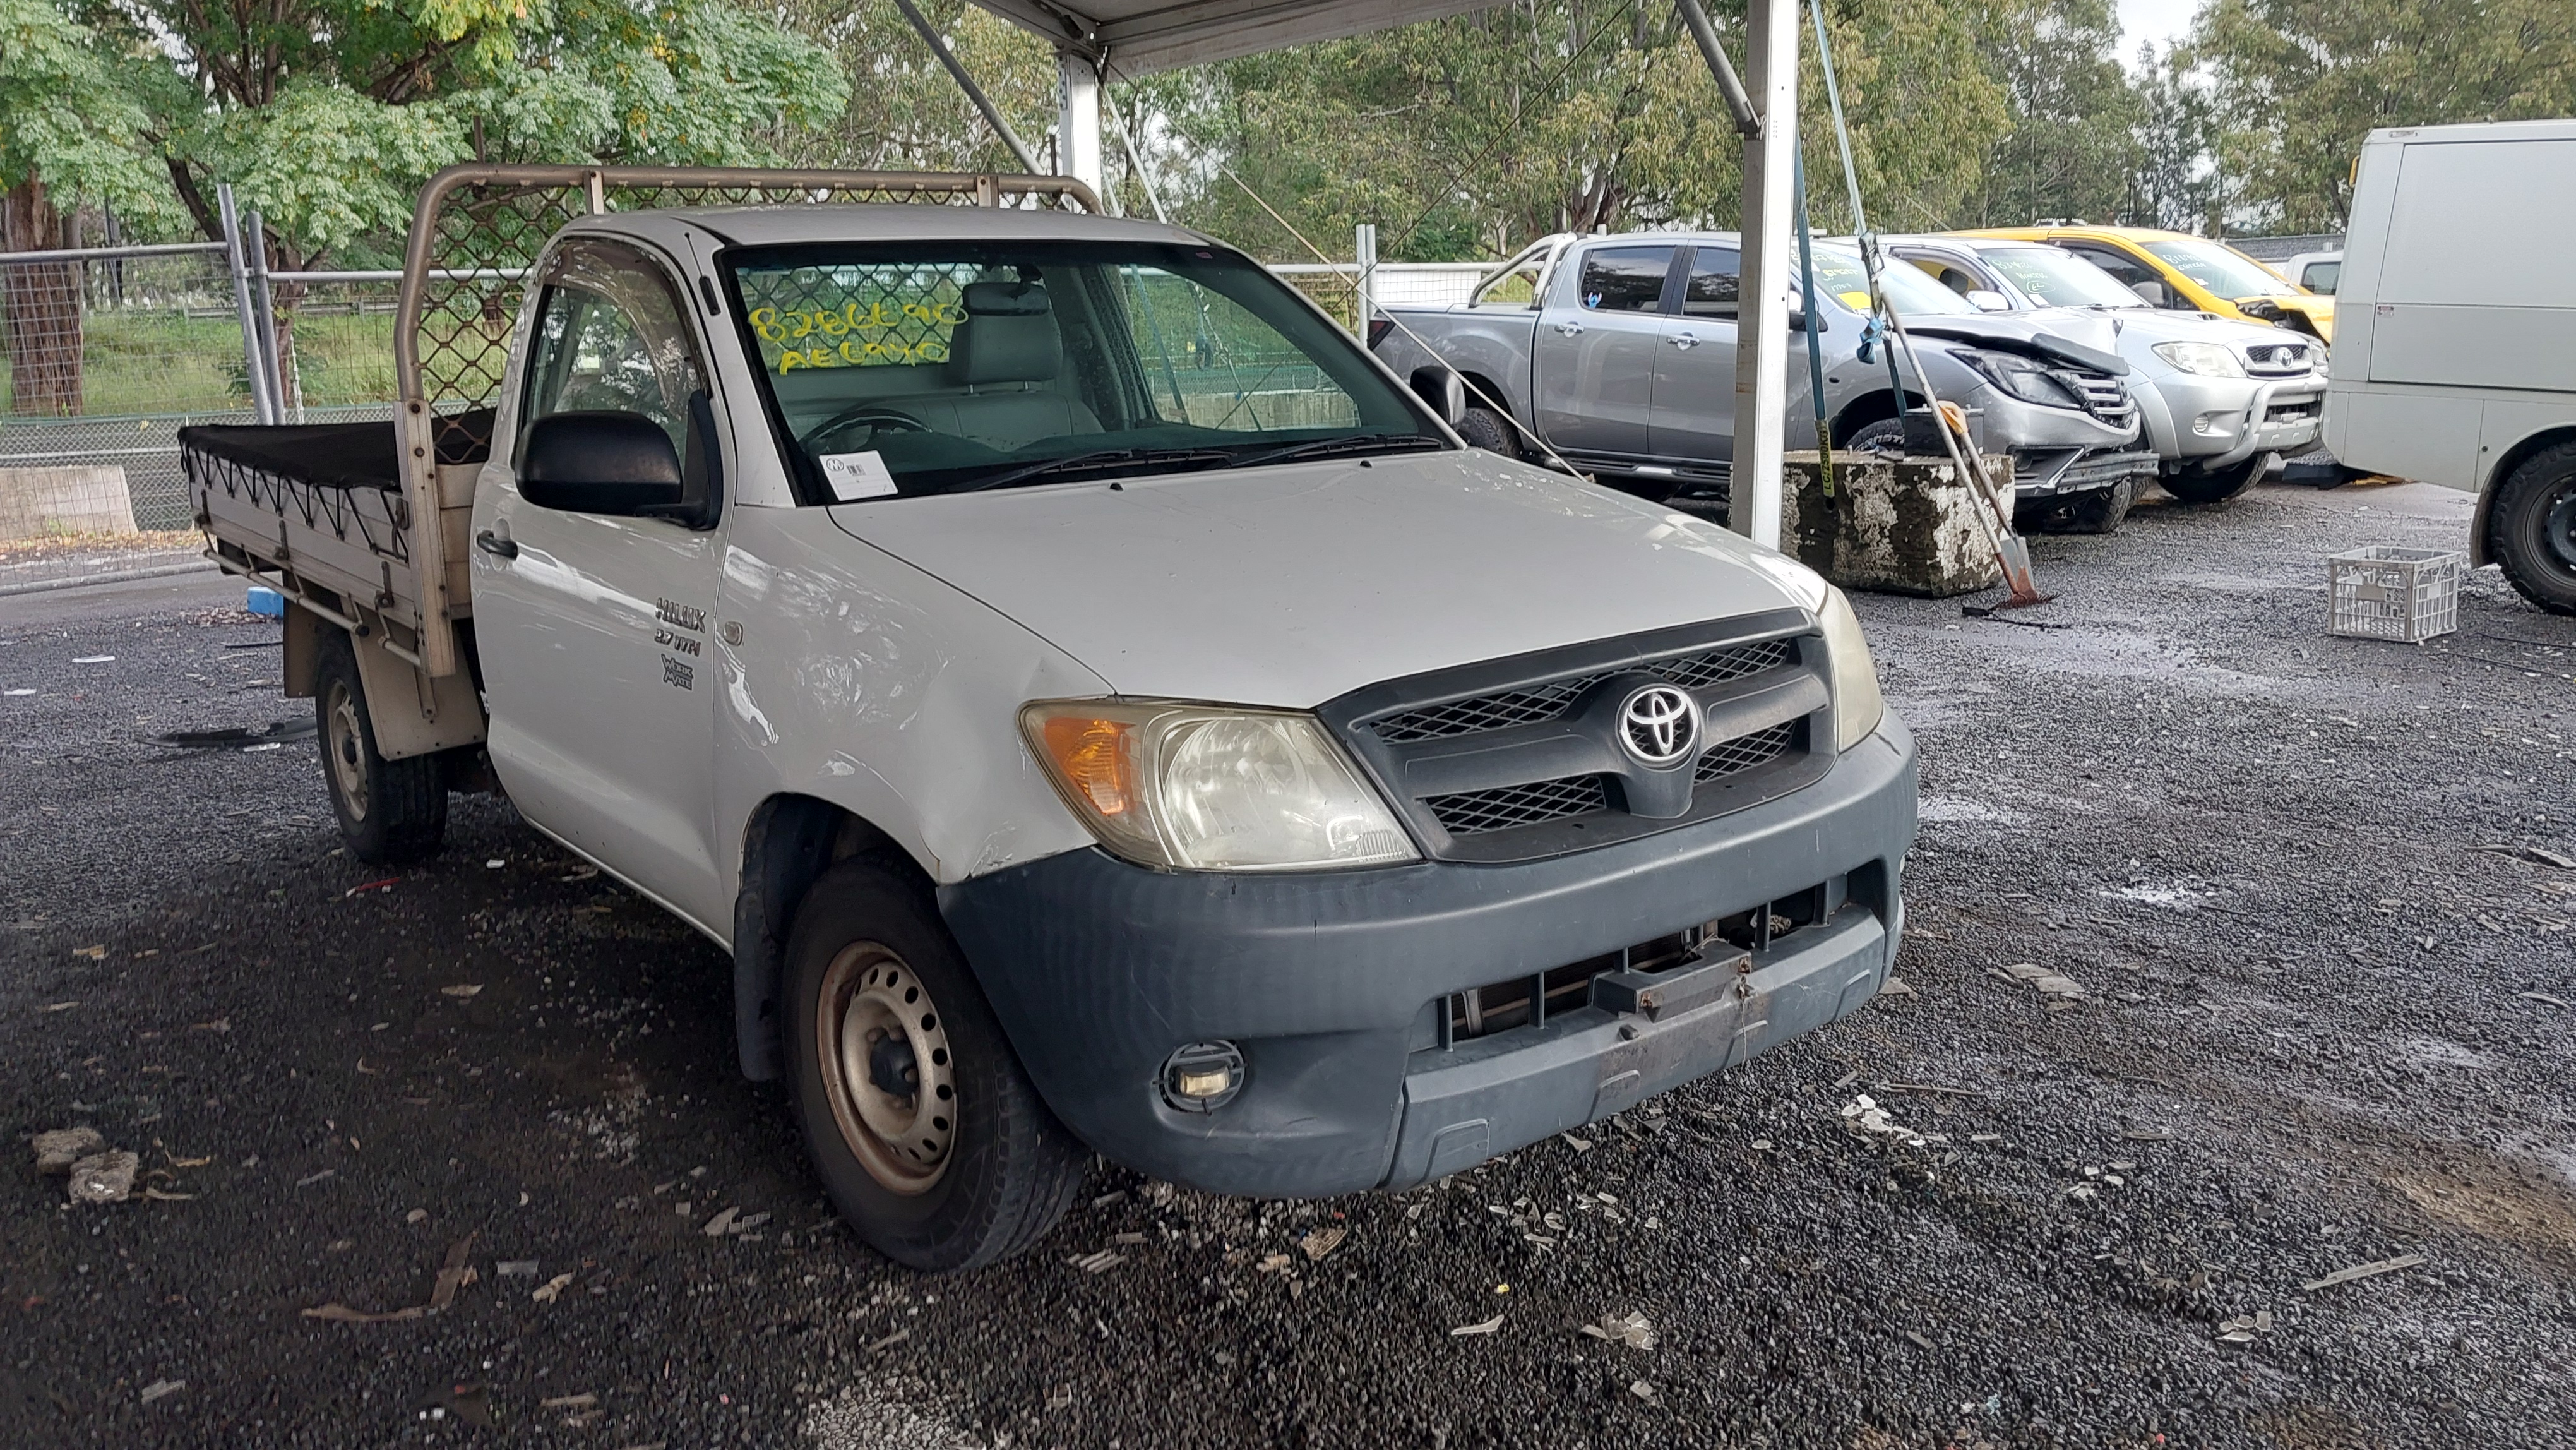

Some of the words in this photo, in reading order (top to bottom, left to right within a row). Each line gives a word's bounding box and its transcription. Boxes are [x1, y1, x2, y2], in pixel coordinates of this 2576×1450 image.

[655, 597, 707, 634] HILUX
[661, 654, 693, 678] WORK
[664, 671, 692, 690] MATE
